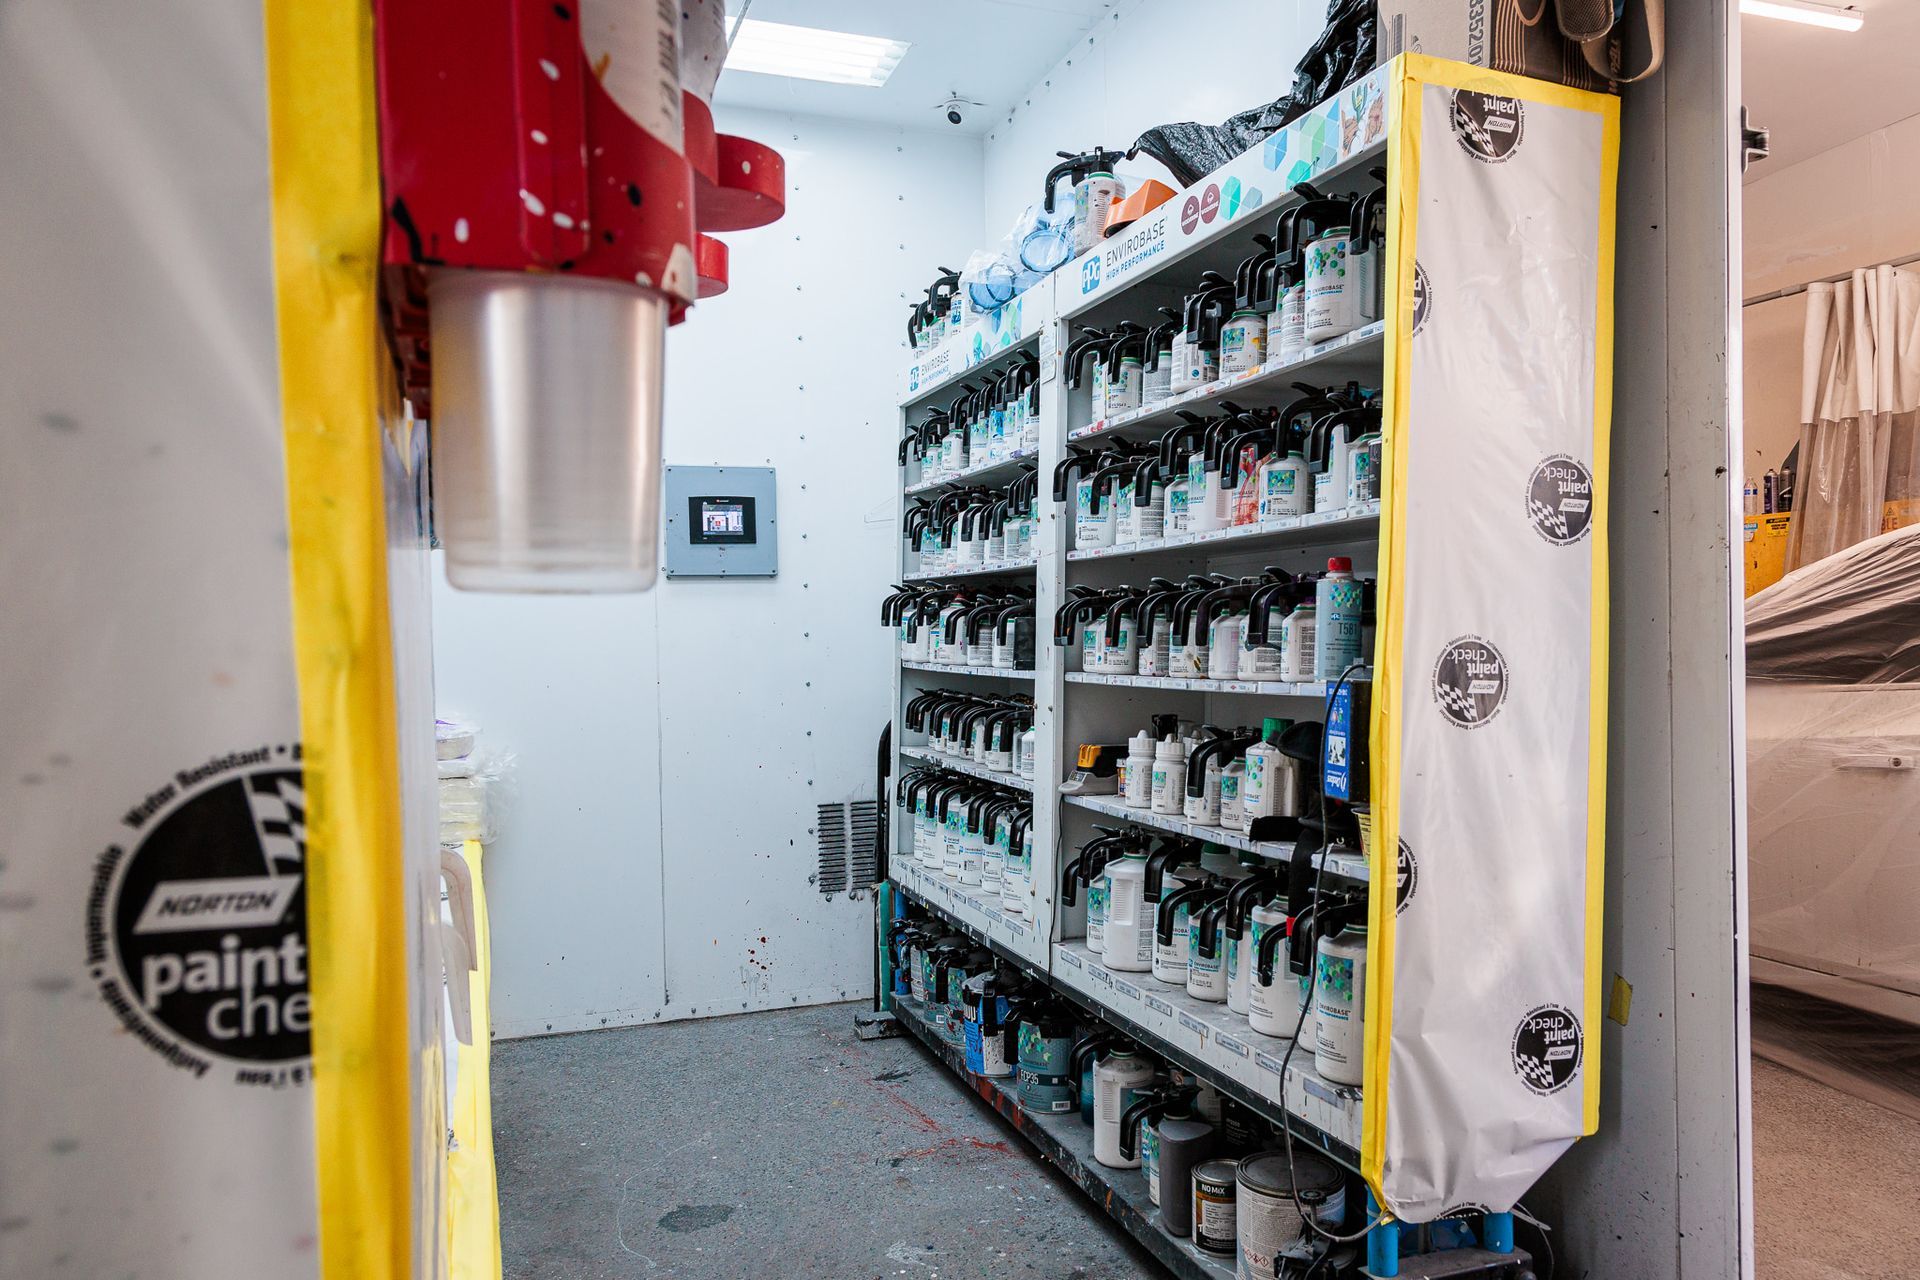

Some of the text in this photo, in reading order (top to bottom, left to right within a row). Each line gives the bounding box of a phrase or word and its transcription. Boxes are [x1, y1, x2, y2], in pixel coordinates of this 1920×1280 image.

[1483, 97, 1515, 114] paint
[1106, 218, 1166, 267] ENVIROBASE
[1105, 240, 1165, 281] HIGH PERFORMANCE
[1544, 467, 1578, 482] check
[1558, 480, 1589, 496] paint
[1452, 648, 1487, 664] check
[1467, 660, 1499, 677] paint
[177, 744, 271, 788] Resistant
[157, 889, 278, 918] NORTON
[141, 932, 307, 1012] paint
[205, 982, 313, 1041] che
[1529, 1016, 1564, 1034] check
[1544, 1025, 1575, 1045] paint
[1202, 1184, 1211, 1192] NO
